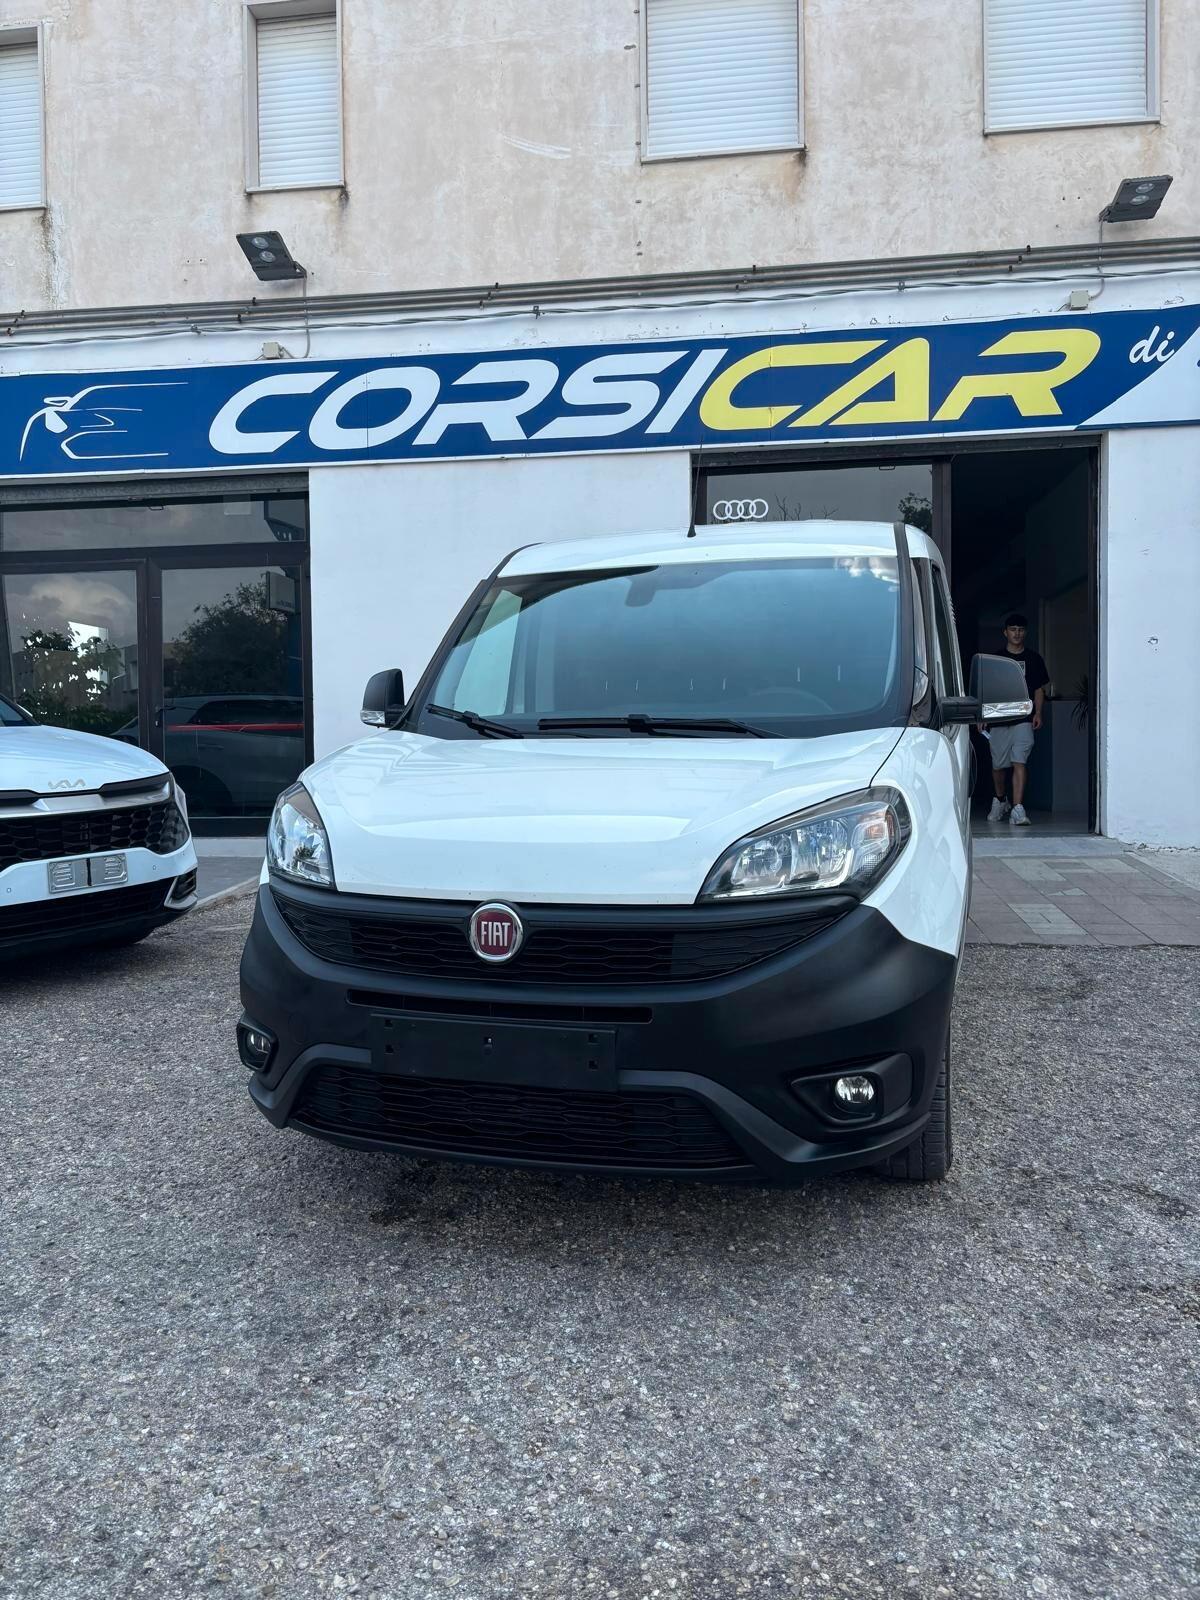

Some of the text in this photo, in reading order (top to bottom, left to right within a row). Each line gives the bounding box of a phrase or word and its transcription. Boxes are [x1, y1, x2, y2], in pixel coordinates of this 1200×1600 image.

[208, 325, 1175, 455] CORSICAR di
[481, 921, 511, 947] FIAT
